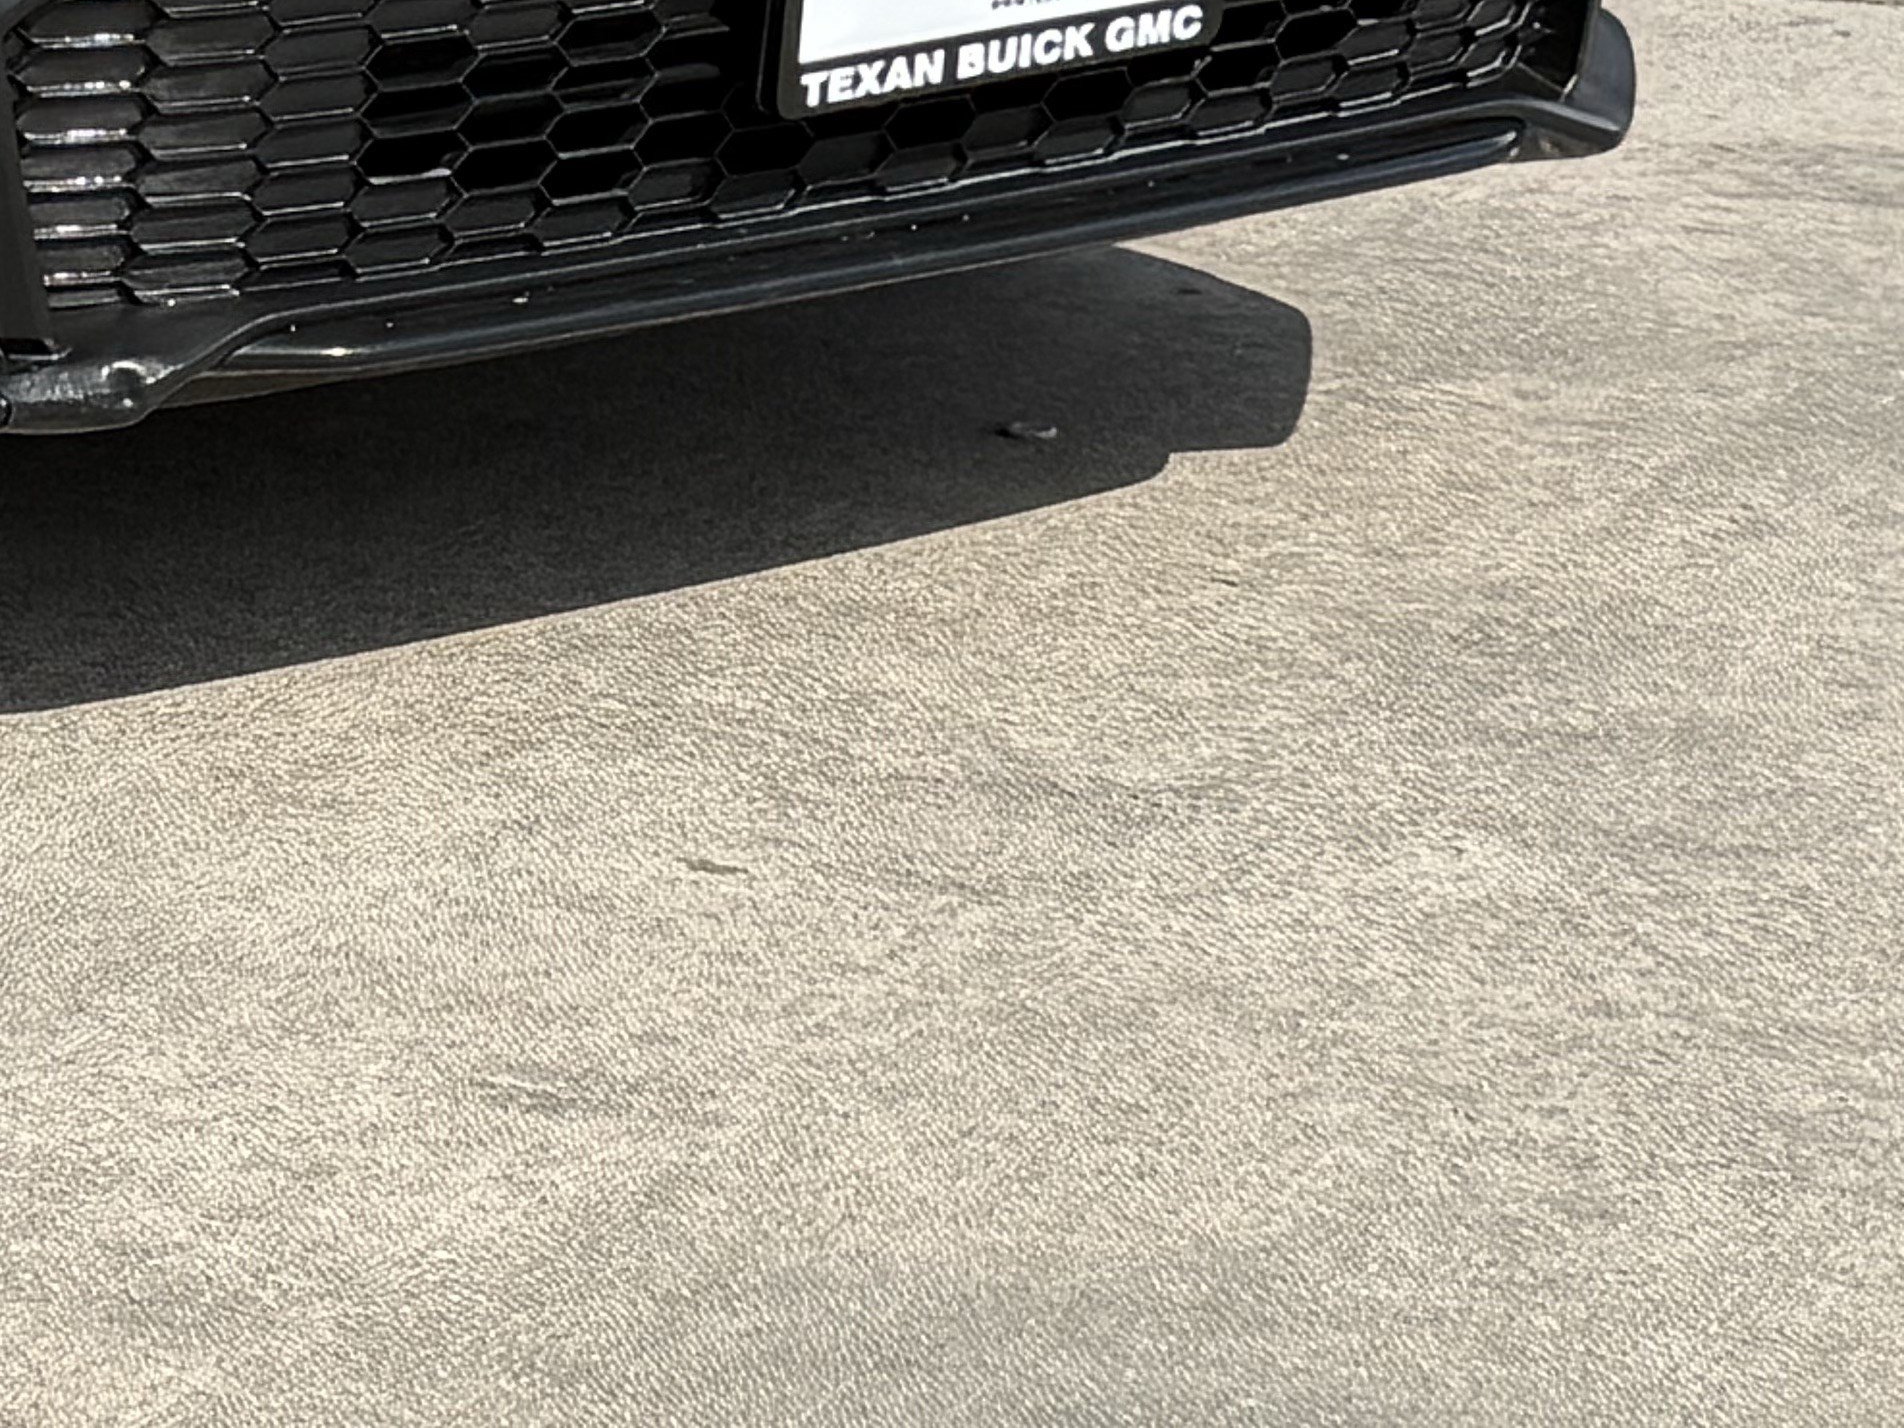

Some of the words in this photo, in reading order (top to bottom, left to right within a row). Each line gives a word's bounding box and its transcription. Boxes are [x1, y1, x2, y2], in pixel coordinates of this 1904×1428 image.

[800, 48, 944, 107] TEXAN
[956, 23, 1094, 79] BUICK
[1103, 5, 1203, 52] GMC
